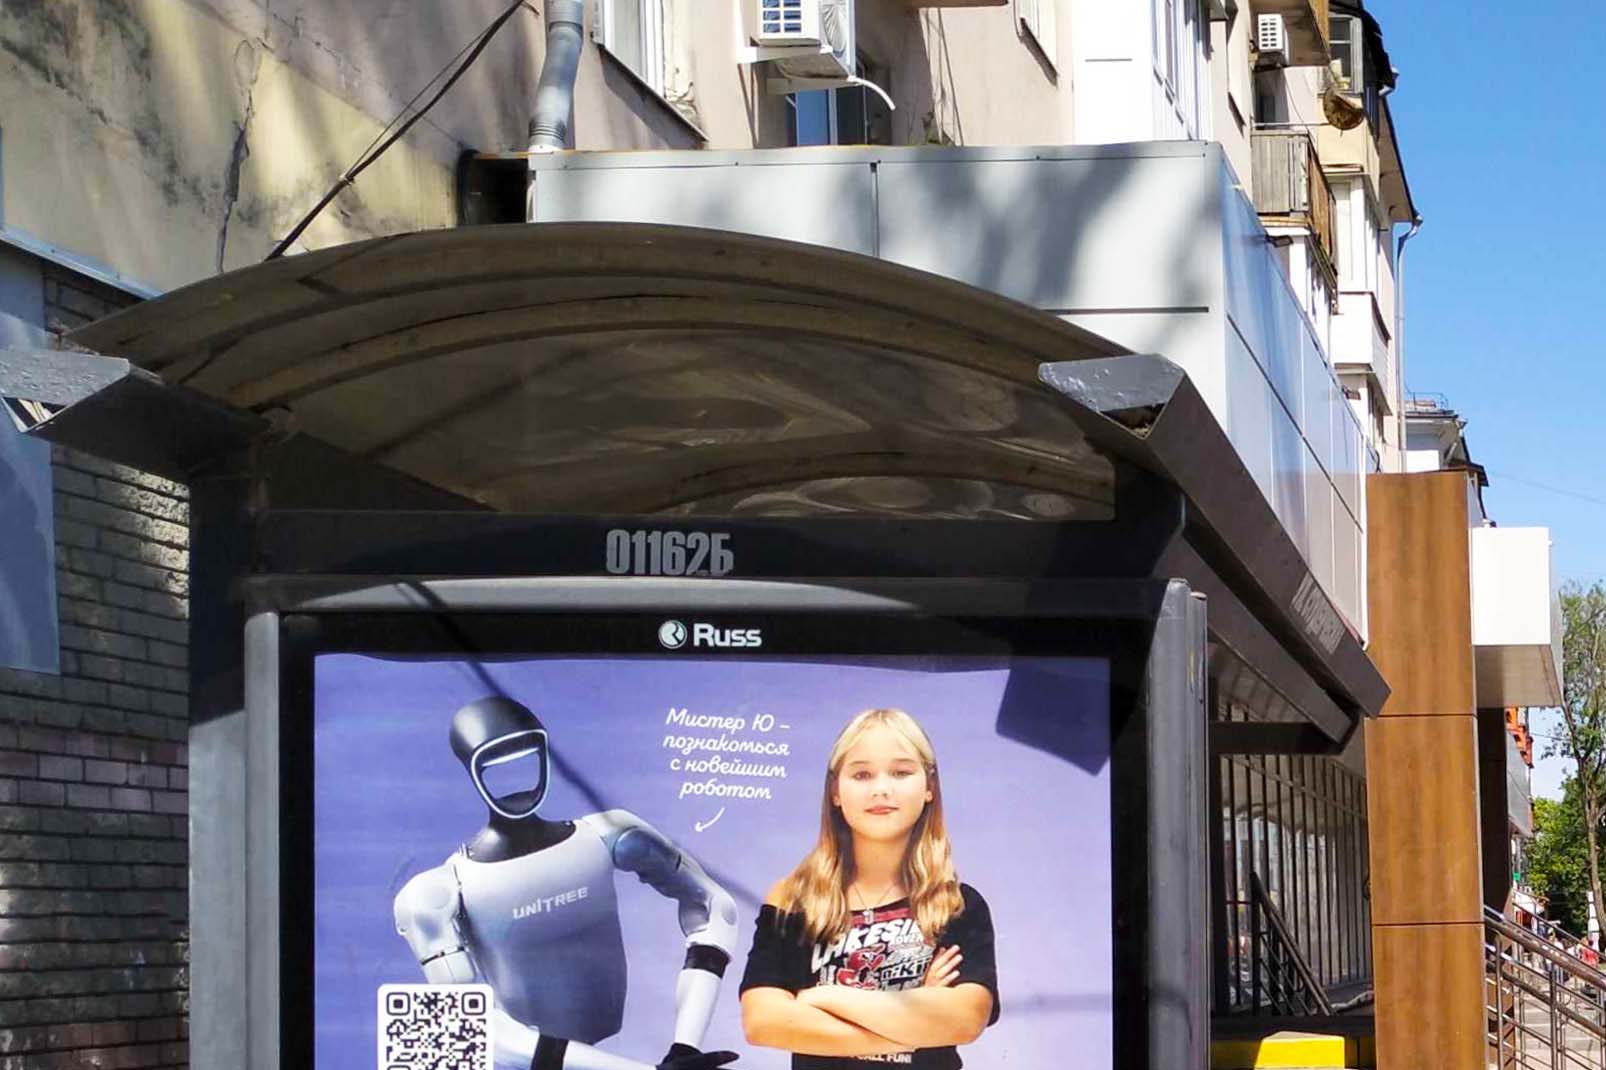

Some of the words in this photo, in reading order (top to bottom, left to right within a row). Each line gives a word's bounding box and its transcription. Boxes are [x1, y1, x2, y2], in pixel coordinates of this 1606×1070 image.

[693, 622, 763, 648] Russ
[664, 707, 746, 735] Мистер
[751, 713, 775, 732] Ю
[662, 733, 791, 756] познакомься
[670, 757, 682, 770] с
[684, 754, 788, 778] новейшим
[678, 777, 772, 800] роботом
[512, 886, 588, 919] UNITREE
